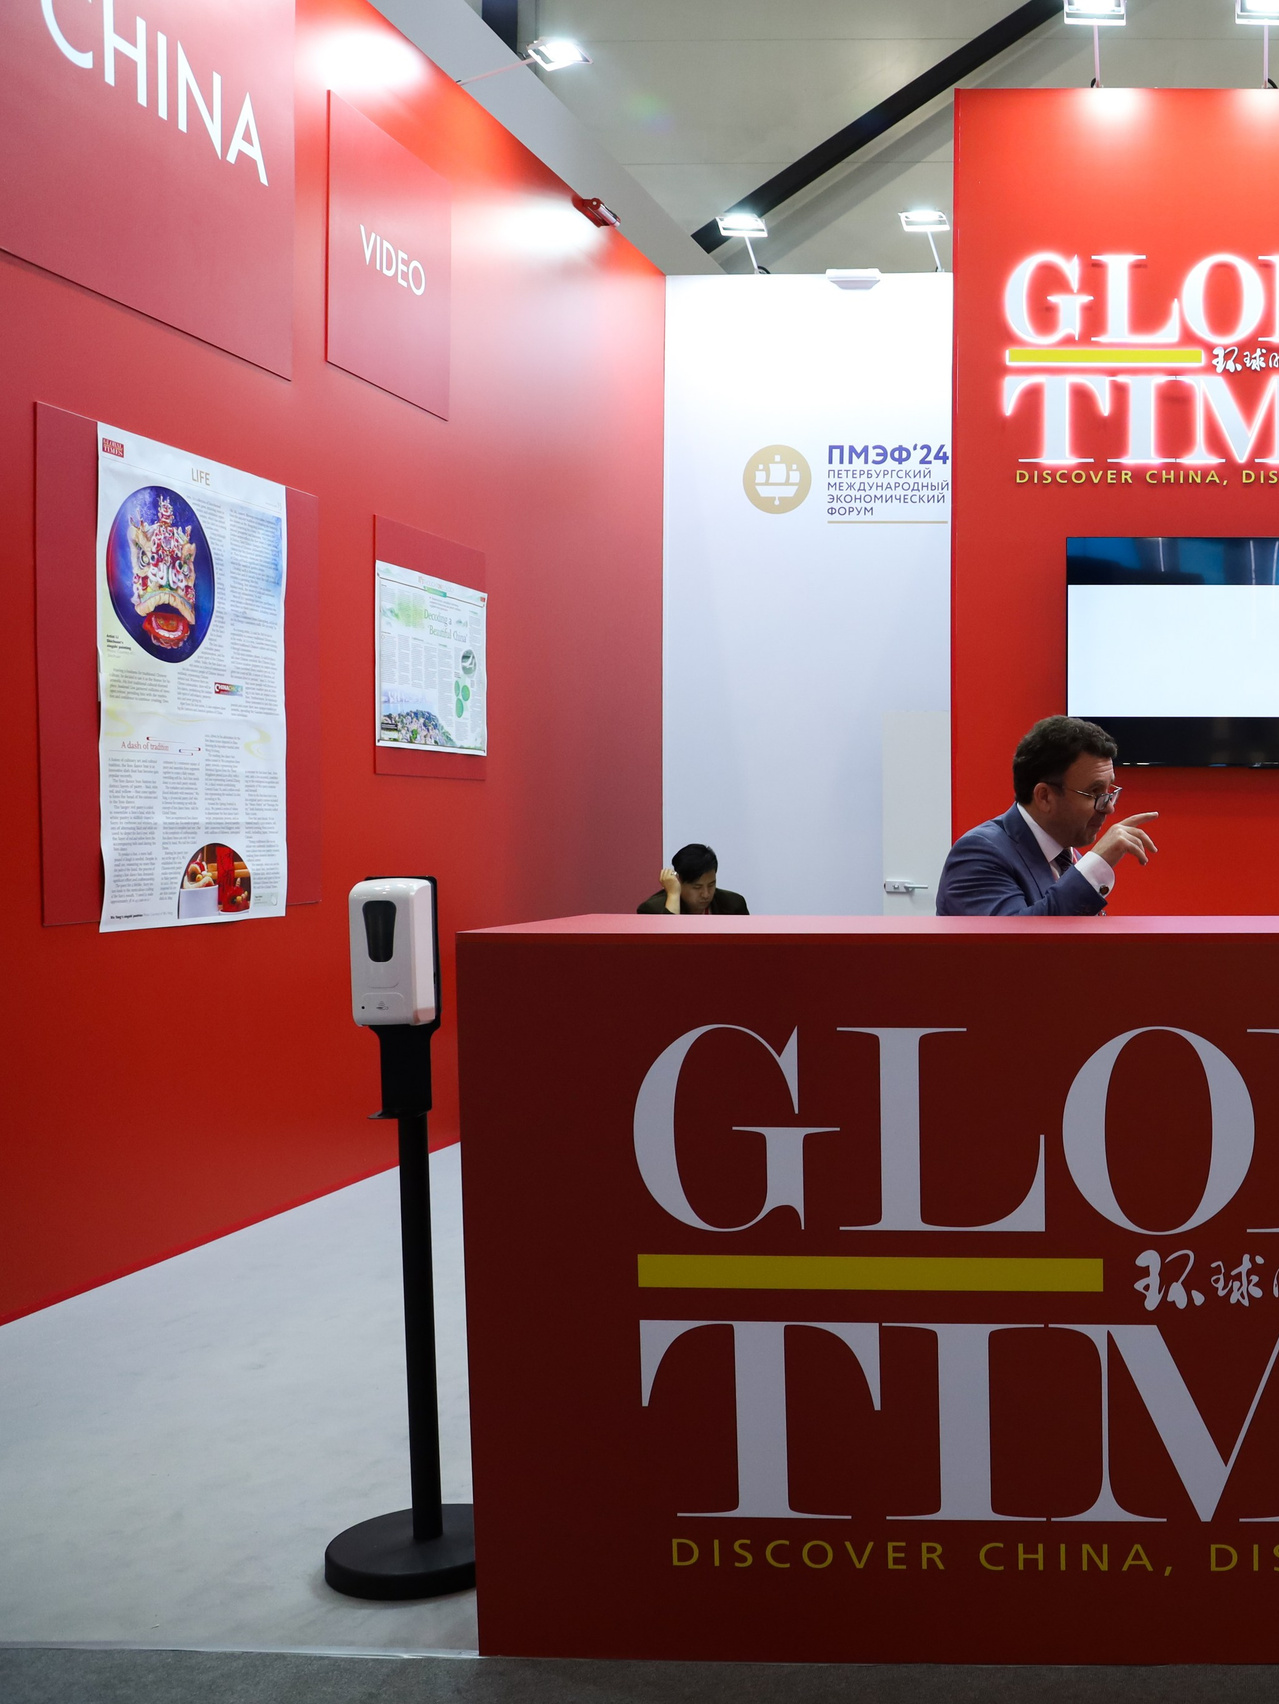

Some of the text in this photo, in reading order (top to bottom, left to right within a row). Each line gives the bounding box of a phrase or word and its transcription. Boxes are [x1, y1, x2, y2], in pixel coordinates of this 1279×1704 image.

[41, 0, 269, 187] CHINA
[359, 224, 426, 296] VIDEO
[191, 467, 211, 487] LIFE
[827, 467, 932, 479] ПЕТЕРБУРГСКИЙ
[1016, 470, 1132, 484] DISCOVER
[1146, 471, 1228, 487] CHINA,
[827, 480, 950, 493] МЕЖДУНАРОДНЫЙ
[827, 492, 946, 504] ЭКОНОМИЧЕСКИЙ
[827, 506, 874, 516] ФОРУМ
[424, 609, 449, 627] Decoding
[127, 741, 142, 750] dash
[671, 1538, 946, 1571] DISCOVER
[978, 1542, 1174, 1576] CHINA,
